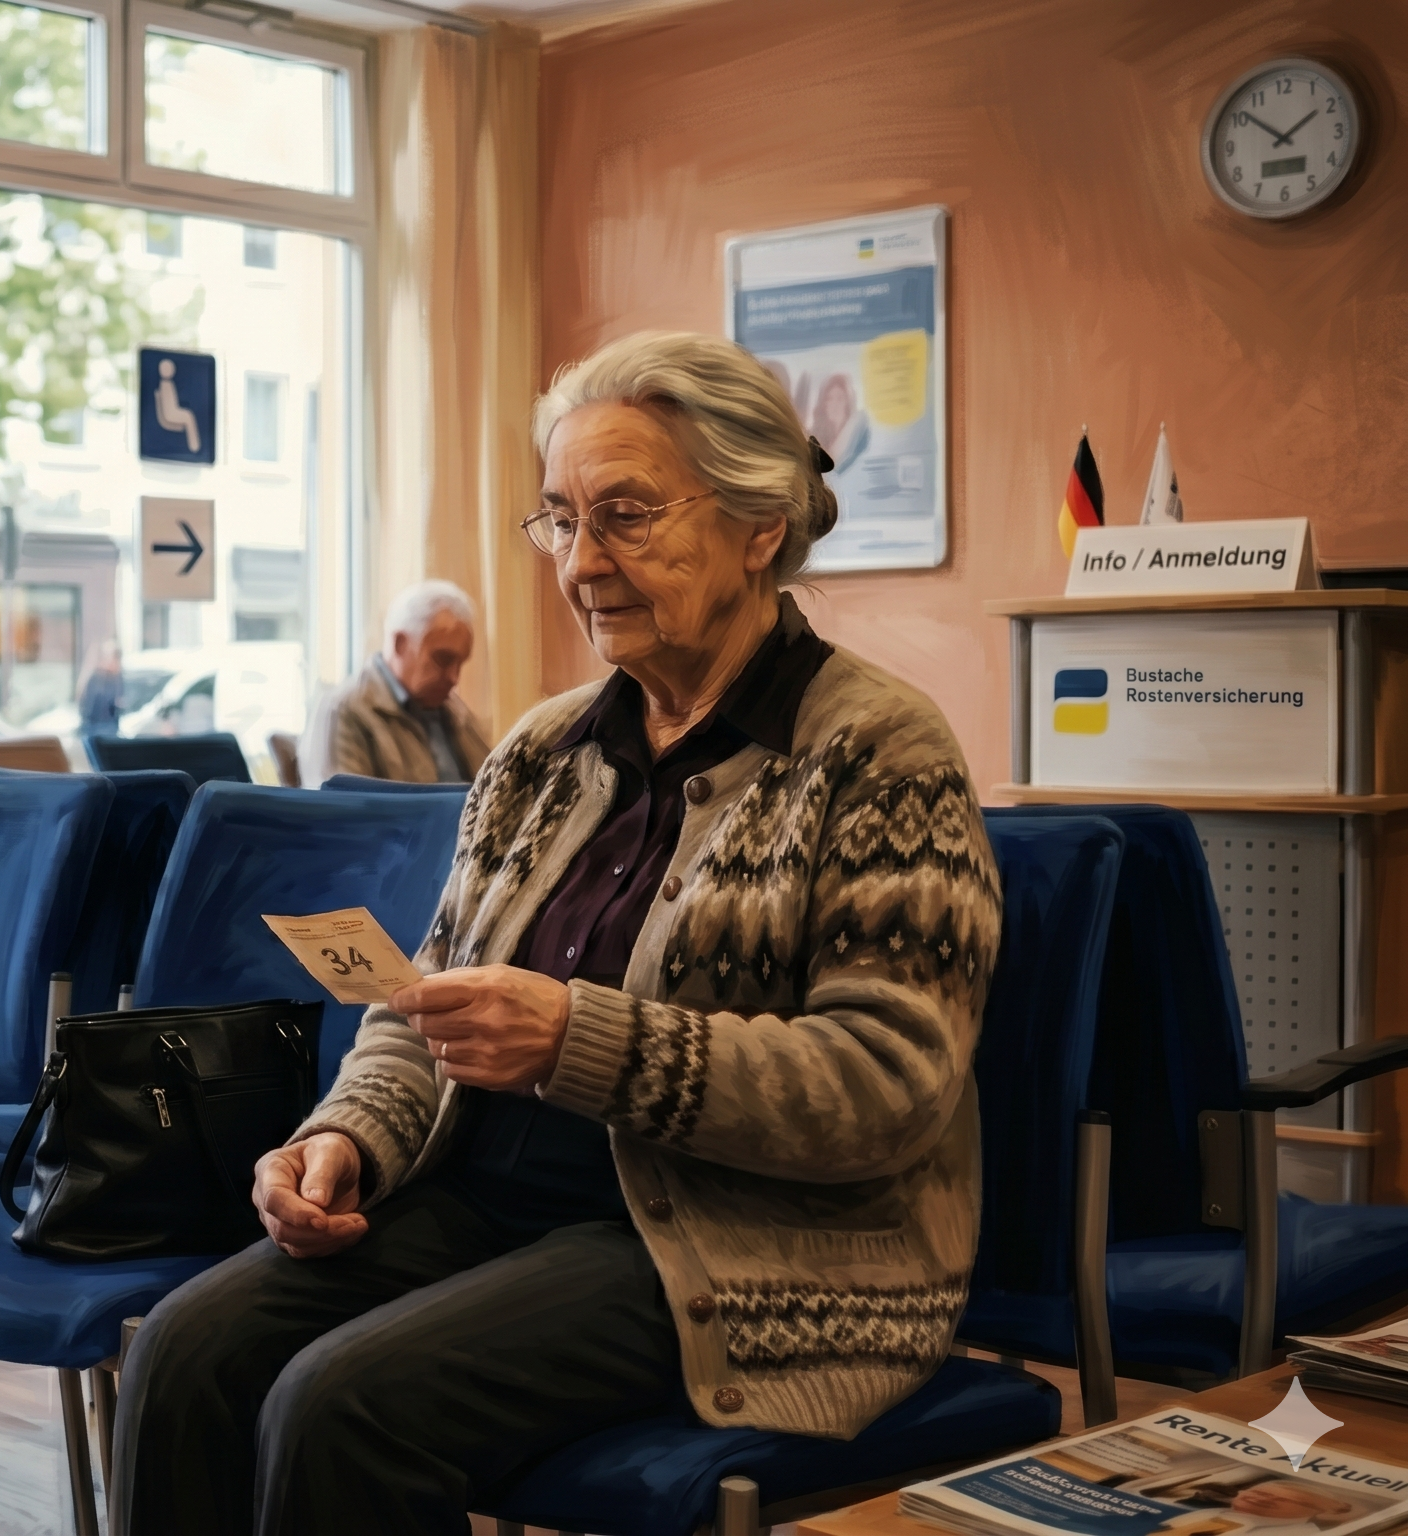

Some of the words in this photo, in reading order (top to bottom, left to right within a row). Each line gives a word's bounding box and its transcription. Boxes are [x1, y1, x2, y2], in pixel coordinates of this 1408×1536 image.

[1275, 78, 1292, 95] 12
[1310, 80, 1315, 96] 1
[1252, 92, 1264, 108] 11
[1326, 98, 1336, 114] 2
[1232, 111, 1249, 128] 10
[1333, 122, 1344, 140] 3
[1225, 140, 1235, 157] 9
[1326, 151, 1336, 167] 4
[1232, 166, 1243, 183] 8
[1253, 182, 1263, 198] 7
[1306, 175, 1316, 192] 5
[1280, 185, 1290, 202] 6
[1082, 549, 1127, 573] Info
[1131, 547, 1144, 572] /
[1148, 546, 1287, 571] Anmeldung
[1125, 667, 1204, 683] Bustache
[1125, 688, 1304, 708] Rostenversicherung
[321, 946, 374, 976] 34
[1153, 1414, 1268, 1457] Rente
